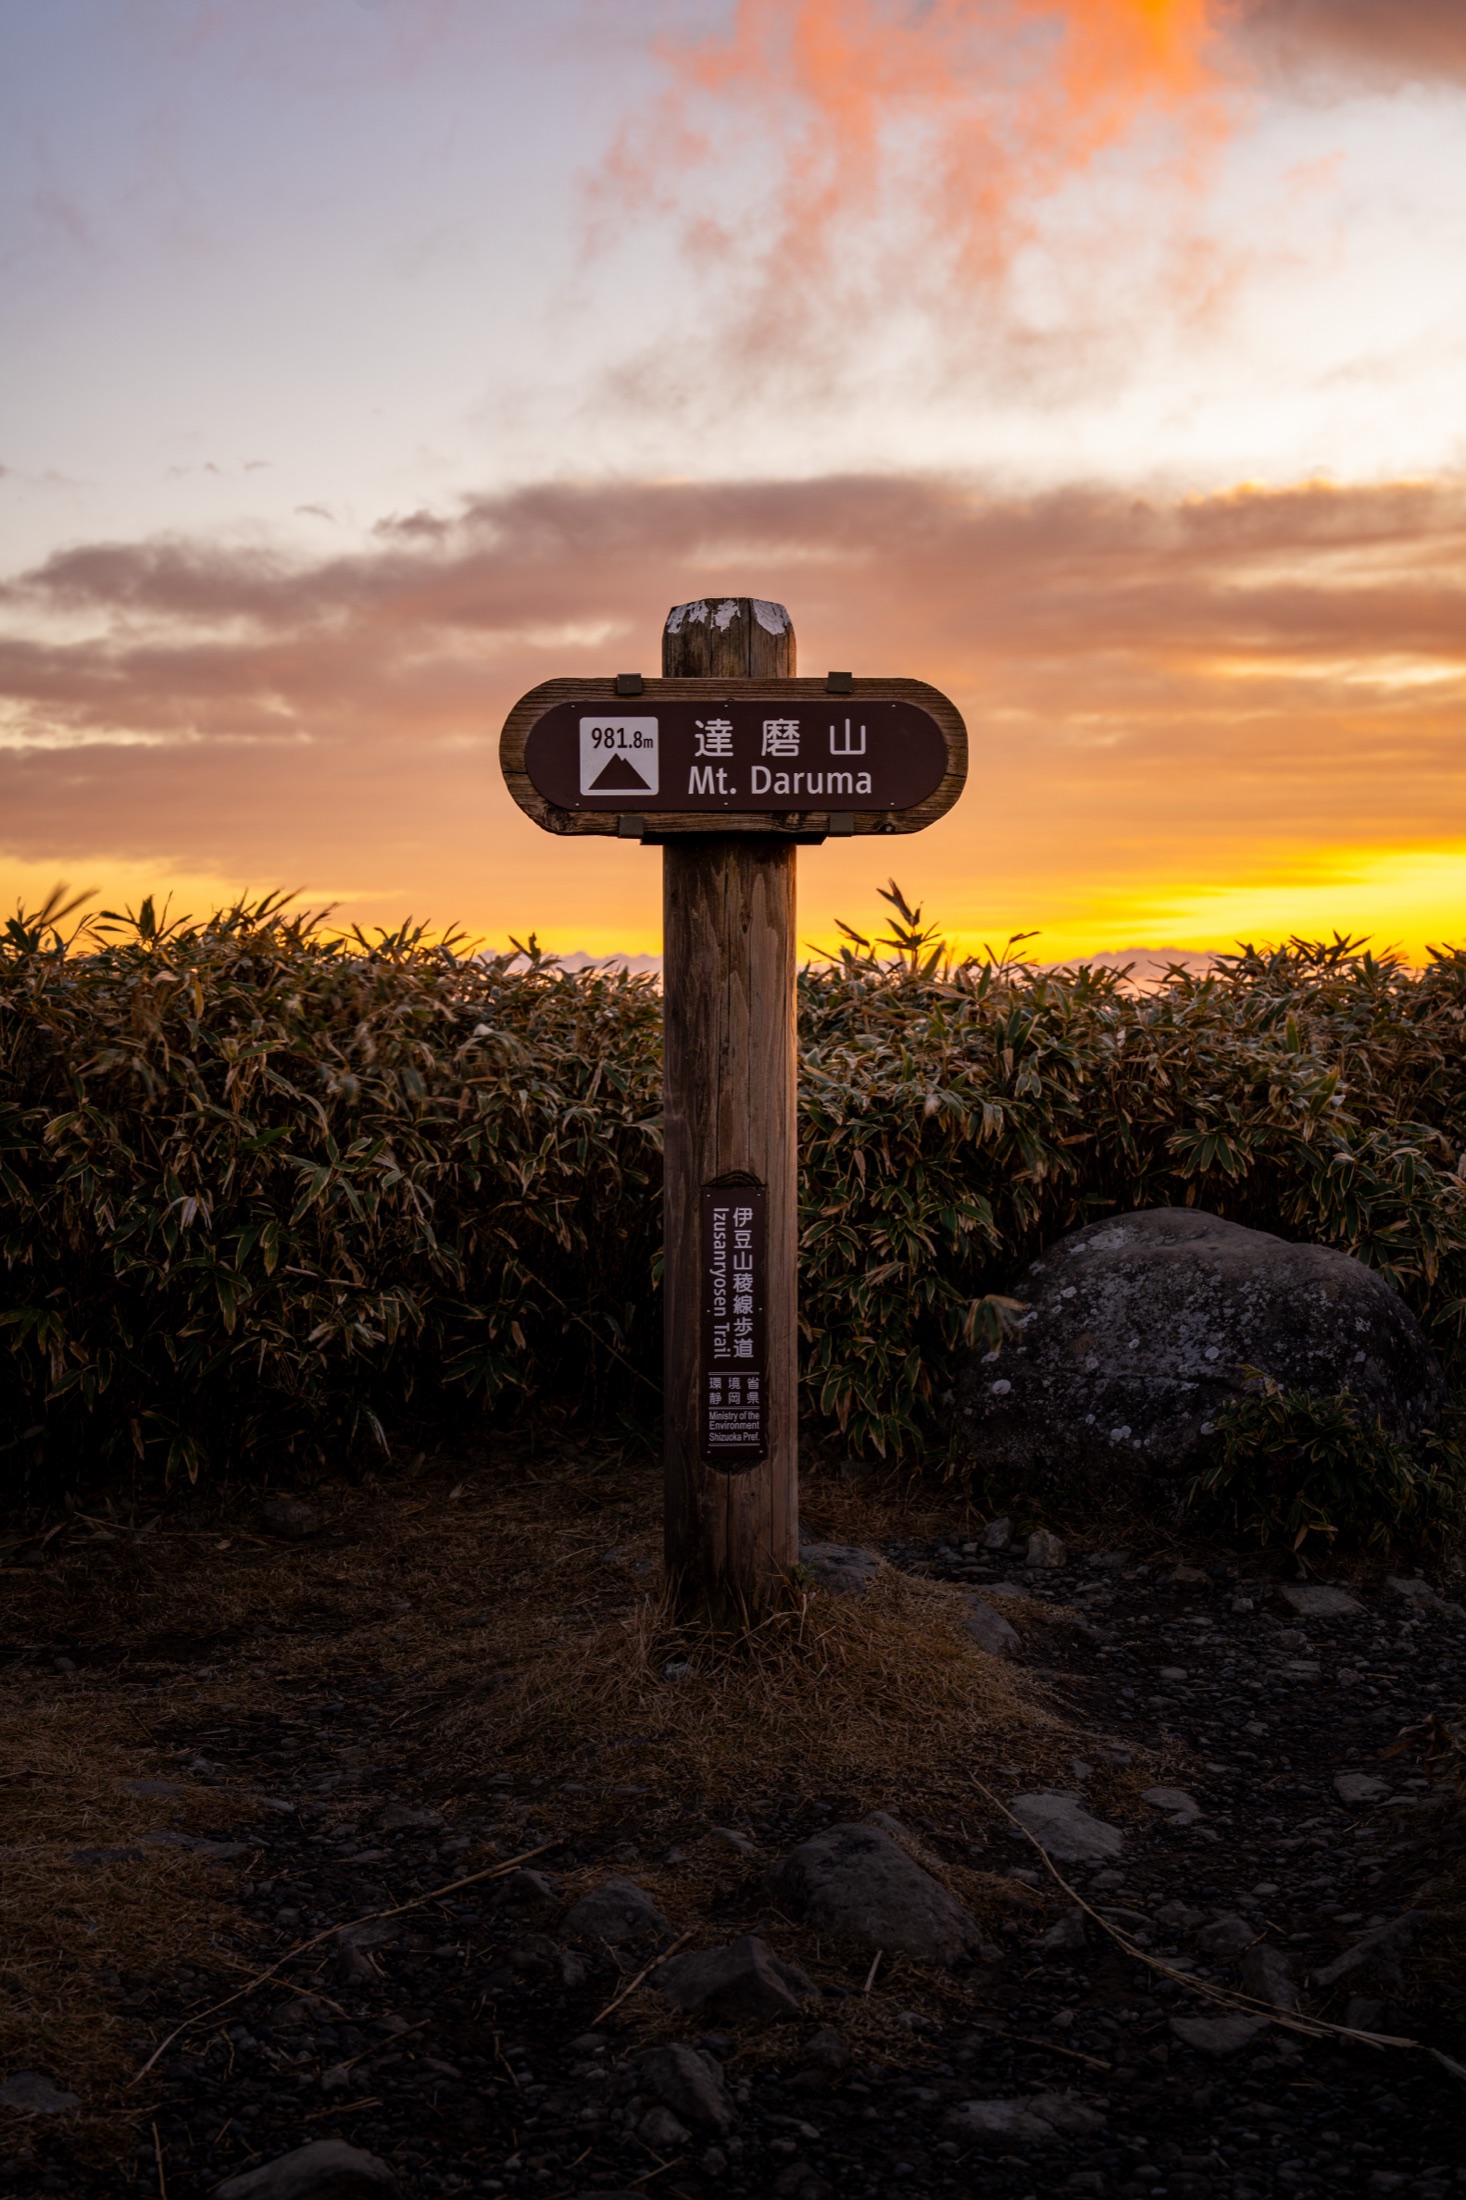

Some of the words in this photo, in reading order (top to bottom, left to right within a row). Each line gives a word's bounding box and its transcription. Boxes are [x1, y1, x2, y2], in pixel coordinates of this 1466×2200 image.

[591, 727, 654, 750] 981.8m
[694, 718, 867, 757] 達磨山
[688, 766, 737, 796] Mt.
[750, 766, 873, 796] Daruma
[709, 1208, 730, 1317] Izusanryosen
[732, 1207, 754, 1358] 伊豆山稜線歩道
[713, 1323, 731, 1359] Trail
[709, 1377, 760, 1389] 環境省
[709, 1391, 760, 1404] 静岡県
[709, 1411, 738, 1422] Ministry
[739, 1411, 747, 1420] of
[748, 1411, 760, 1420] the
[709, 1421, 760, 1430] Environment
[709, 1432, 742, 1442] Shizuoka
[743, 1432, 760, 1441] Pref.
